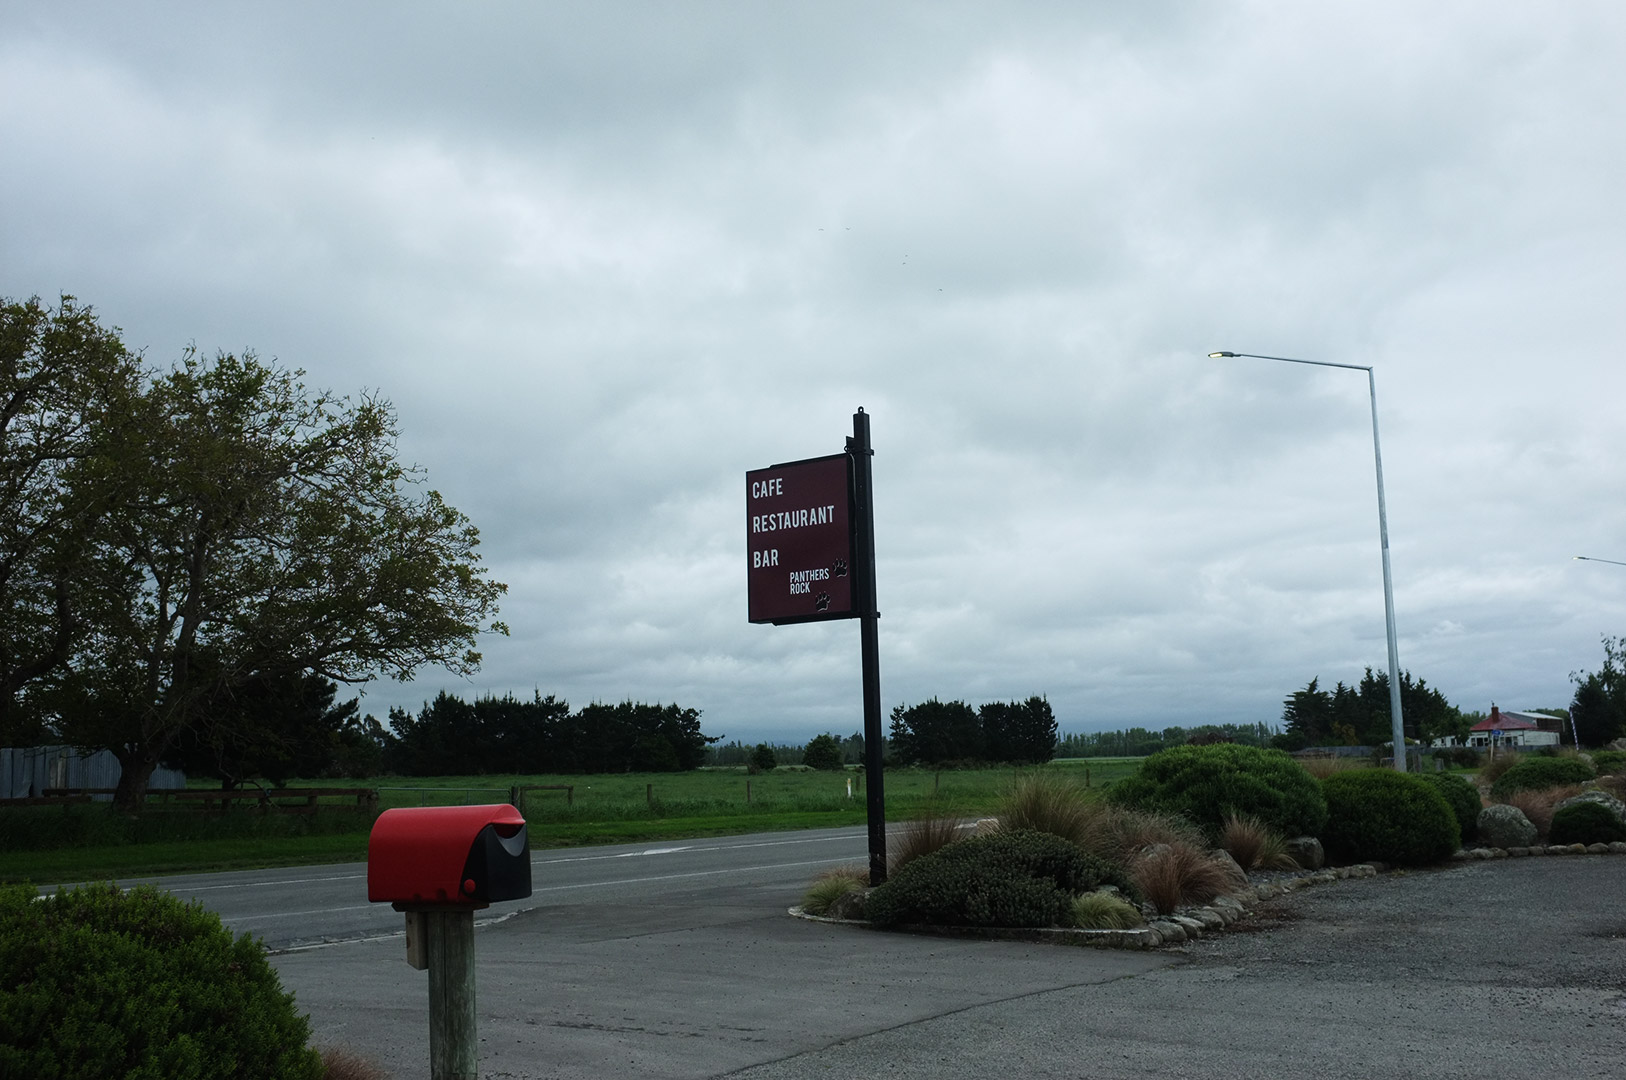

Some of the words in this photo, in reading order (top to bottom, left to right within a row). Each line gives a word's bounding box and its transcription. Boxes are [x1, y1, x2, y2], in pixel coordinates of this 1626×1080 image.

[752, 478, 783, 499] CAFE
[753, 505, 835, 533] RESTAURANT
[753, 549, 779, 569] BAR
[789, 568, 830, 584] PANTHERS
[790, 582, 811, 595] ROCK
